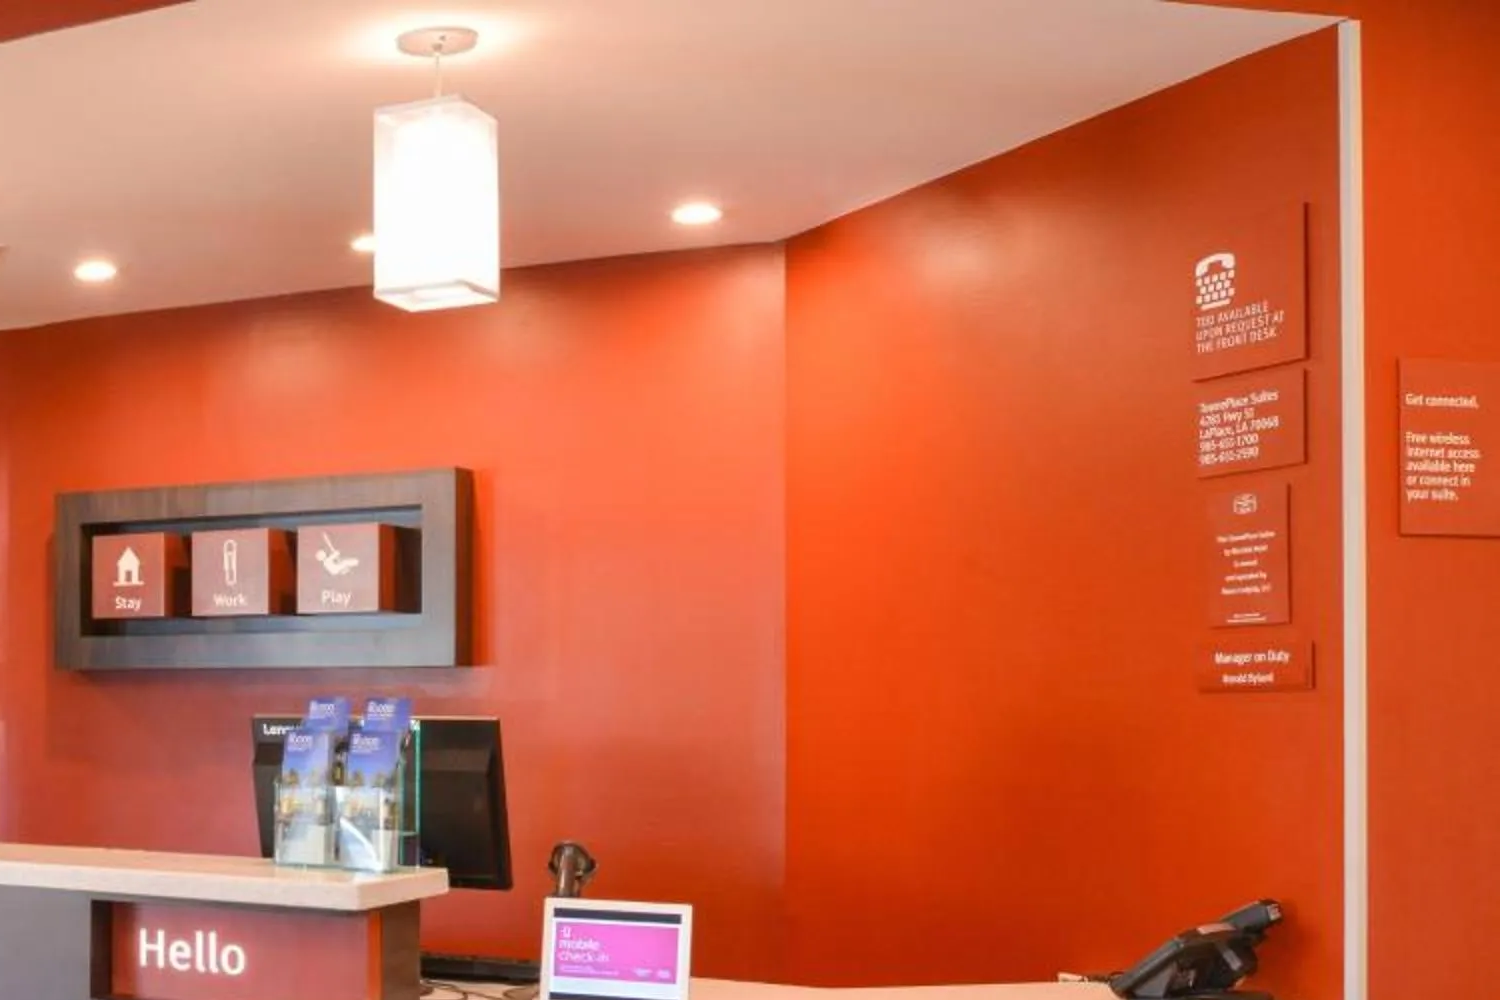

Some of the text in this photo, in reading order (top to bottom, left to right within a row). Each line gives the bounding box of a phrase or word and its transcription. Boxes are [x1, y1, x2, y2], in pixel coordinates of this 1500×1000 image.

[1218, 300, 1269, 324] AVAILABLE
[1196, 309, 1285, 341] UPON REQUEST AT
[1197, 326, 1278, 354] THE FRONT DESK
[1405, 394, 1423, 406] Get
[1235, 420, 1249, 433] LA
[1405, 431, 1470, 445] Free wireless
[1405, 459, 1476, 473] available here
[1419, 475, 1459, 487] connect
[1406, 489, 1429, 503] your
[115, 595, 142, 611] Stay
[213, 593, 248, 607] Work
[320, 589, 352, 606] Play
[1214, 649, 1290, 666] Manager on Duty
[138, 927, 246, 976] Hello
